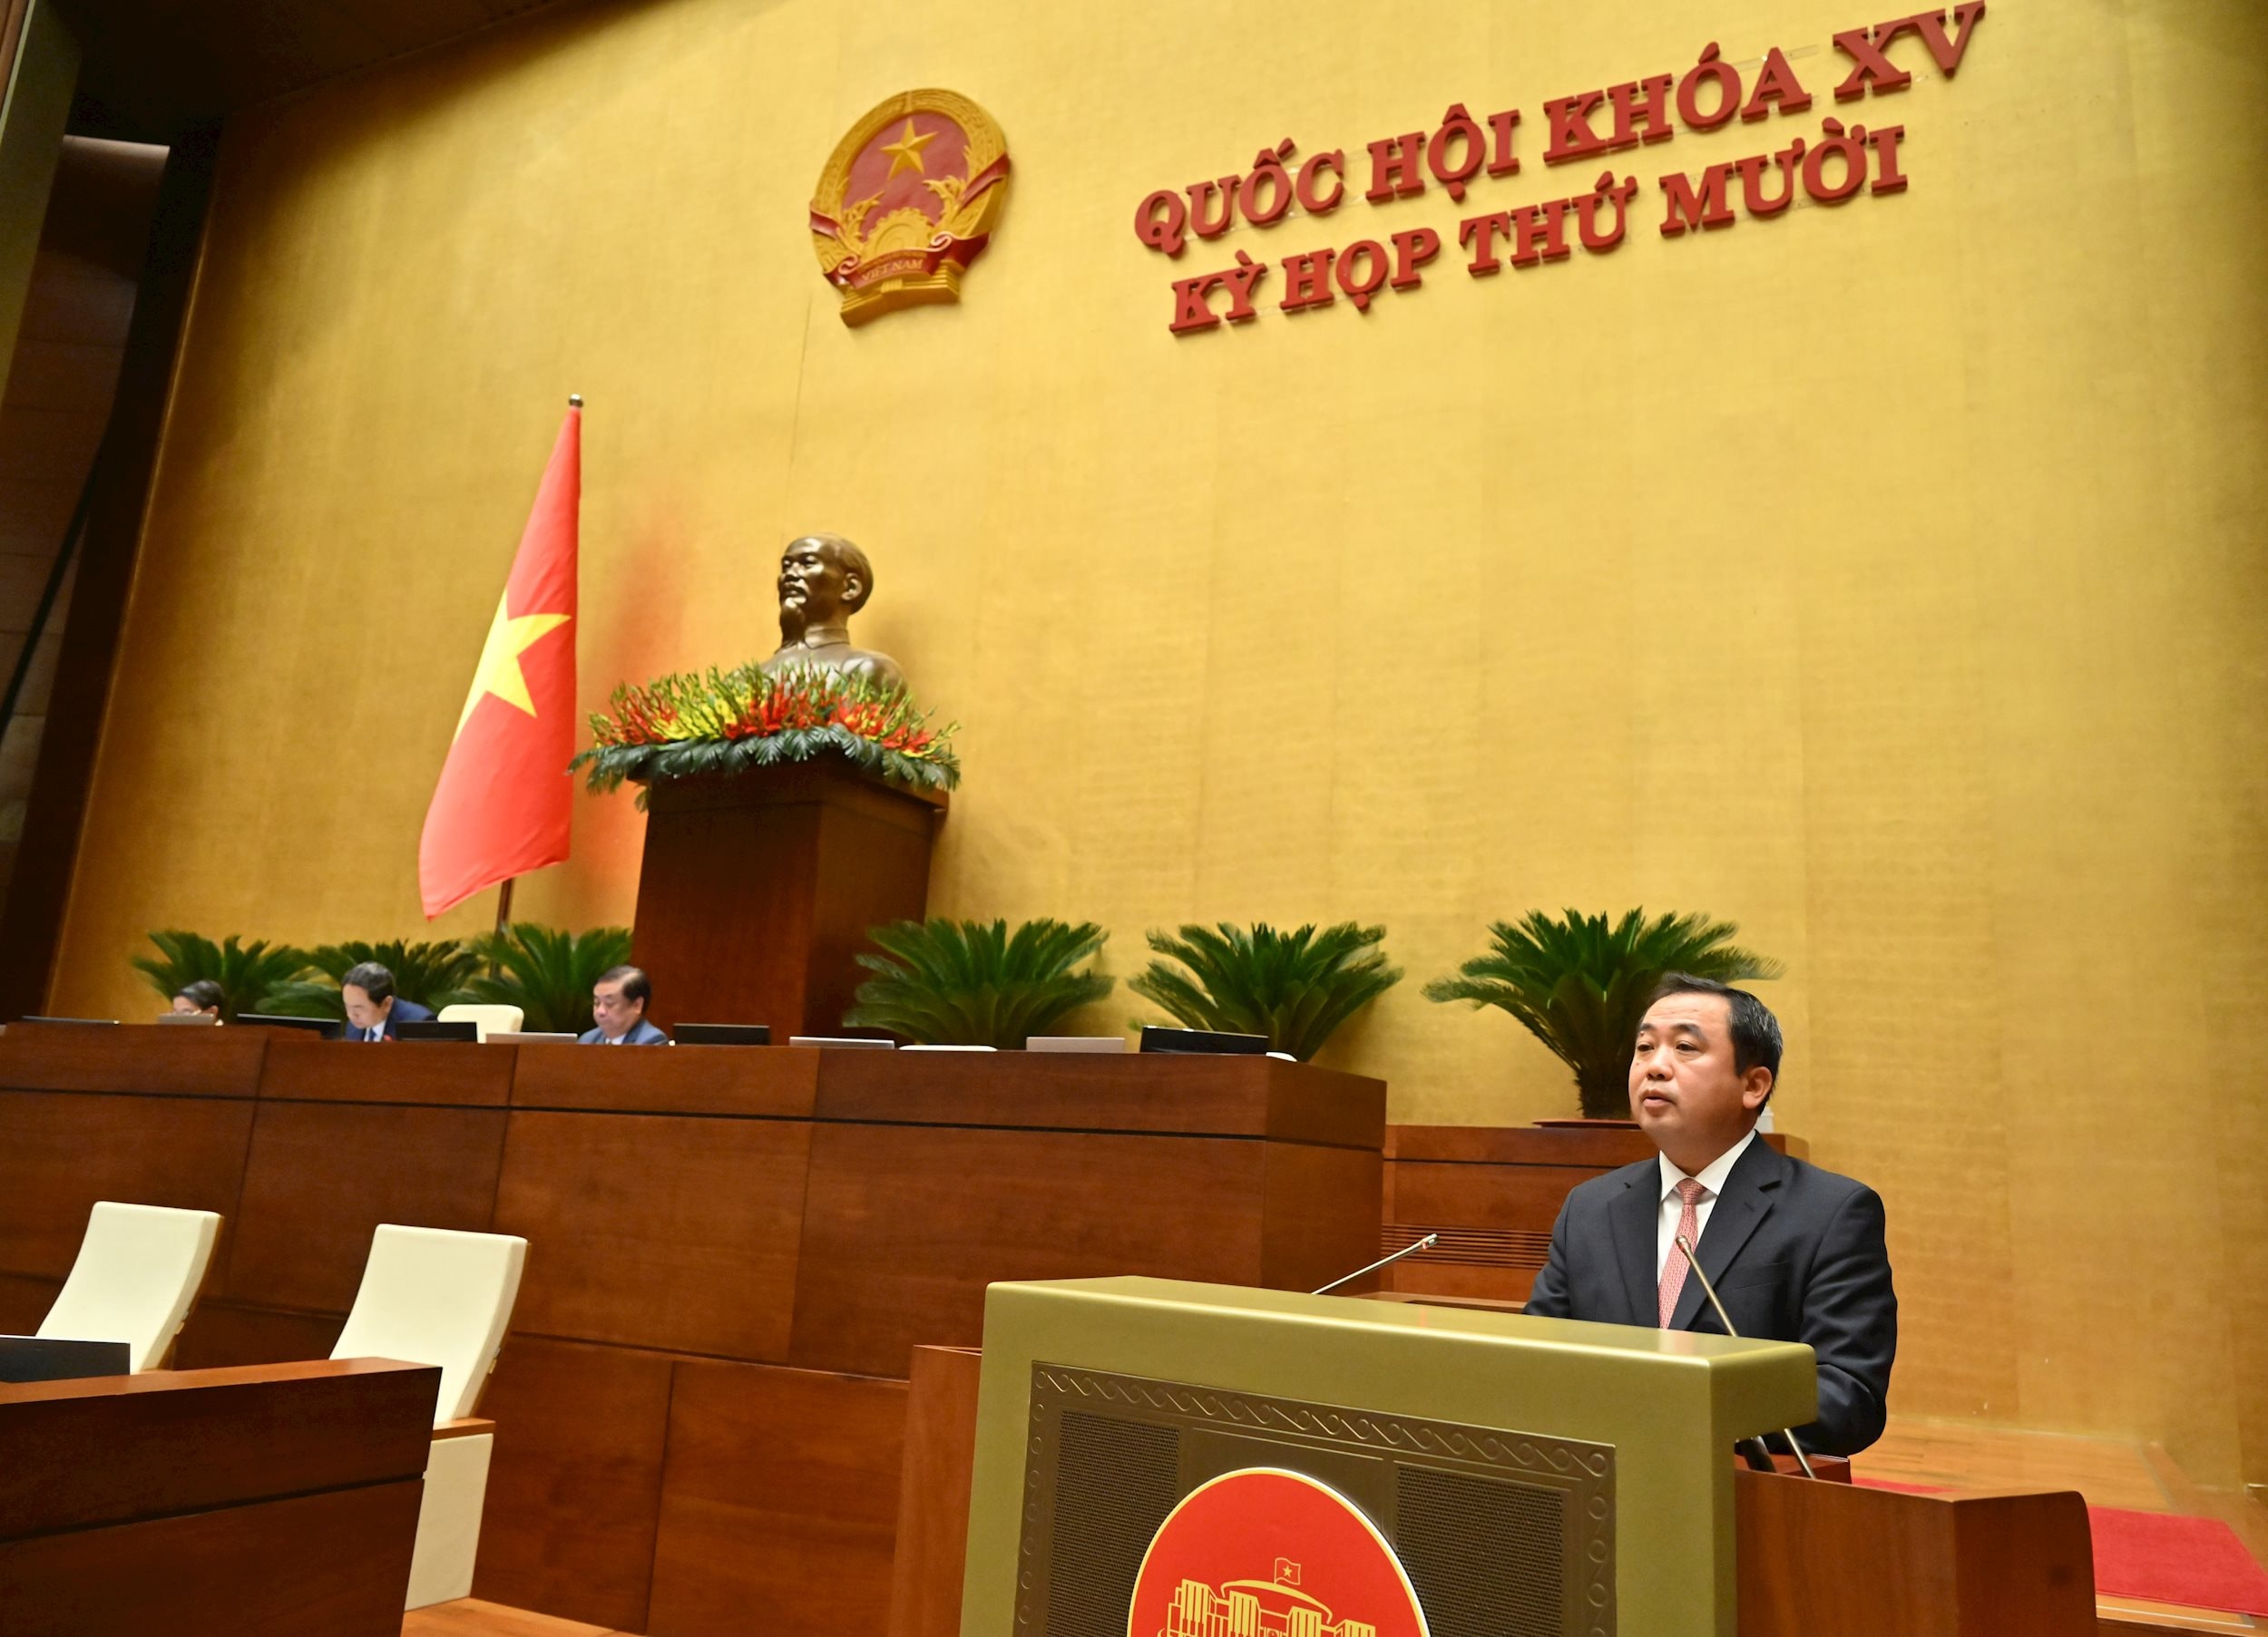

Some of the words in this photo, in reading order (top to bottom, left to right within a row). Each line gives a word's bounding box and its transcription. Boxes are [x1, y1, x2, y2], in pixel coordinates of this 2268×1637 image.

[1135, 139, 1344, 258] QUỐC
[1365, 104, 1520, 202] HỘI
[1543, 42, 1813, 164] KHÓA
[1833, 1, 1985, 100] XV
[1170, 251, 1267, 335] KỲ
[1280, 229, 1440, 312] HỌP
[1460, 171, 1637, 275] THỨ
[1659, 118, 1908, 235] MƯỜI
[892, 258, 924, 271] NAM
